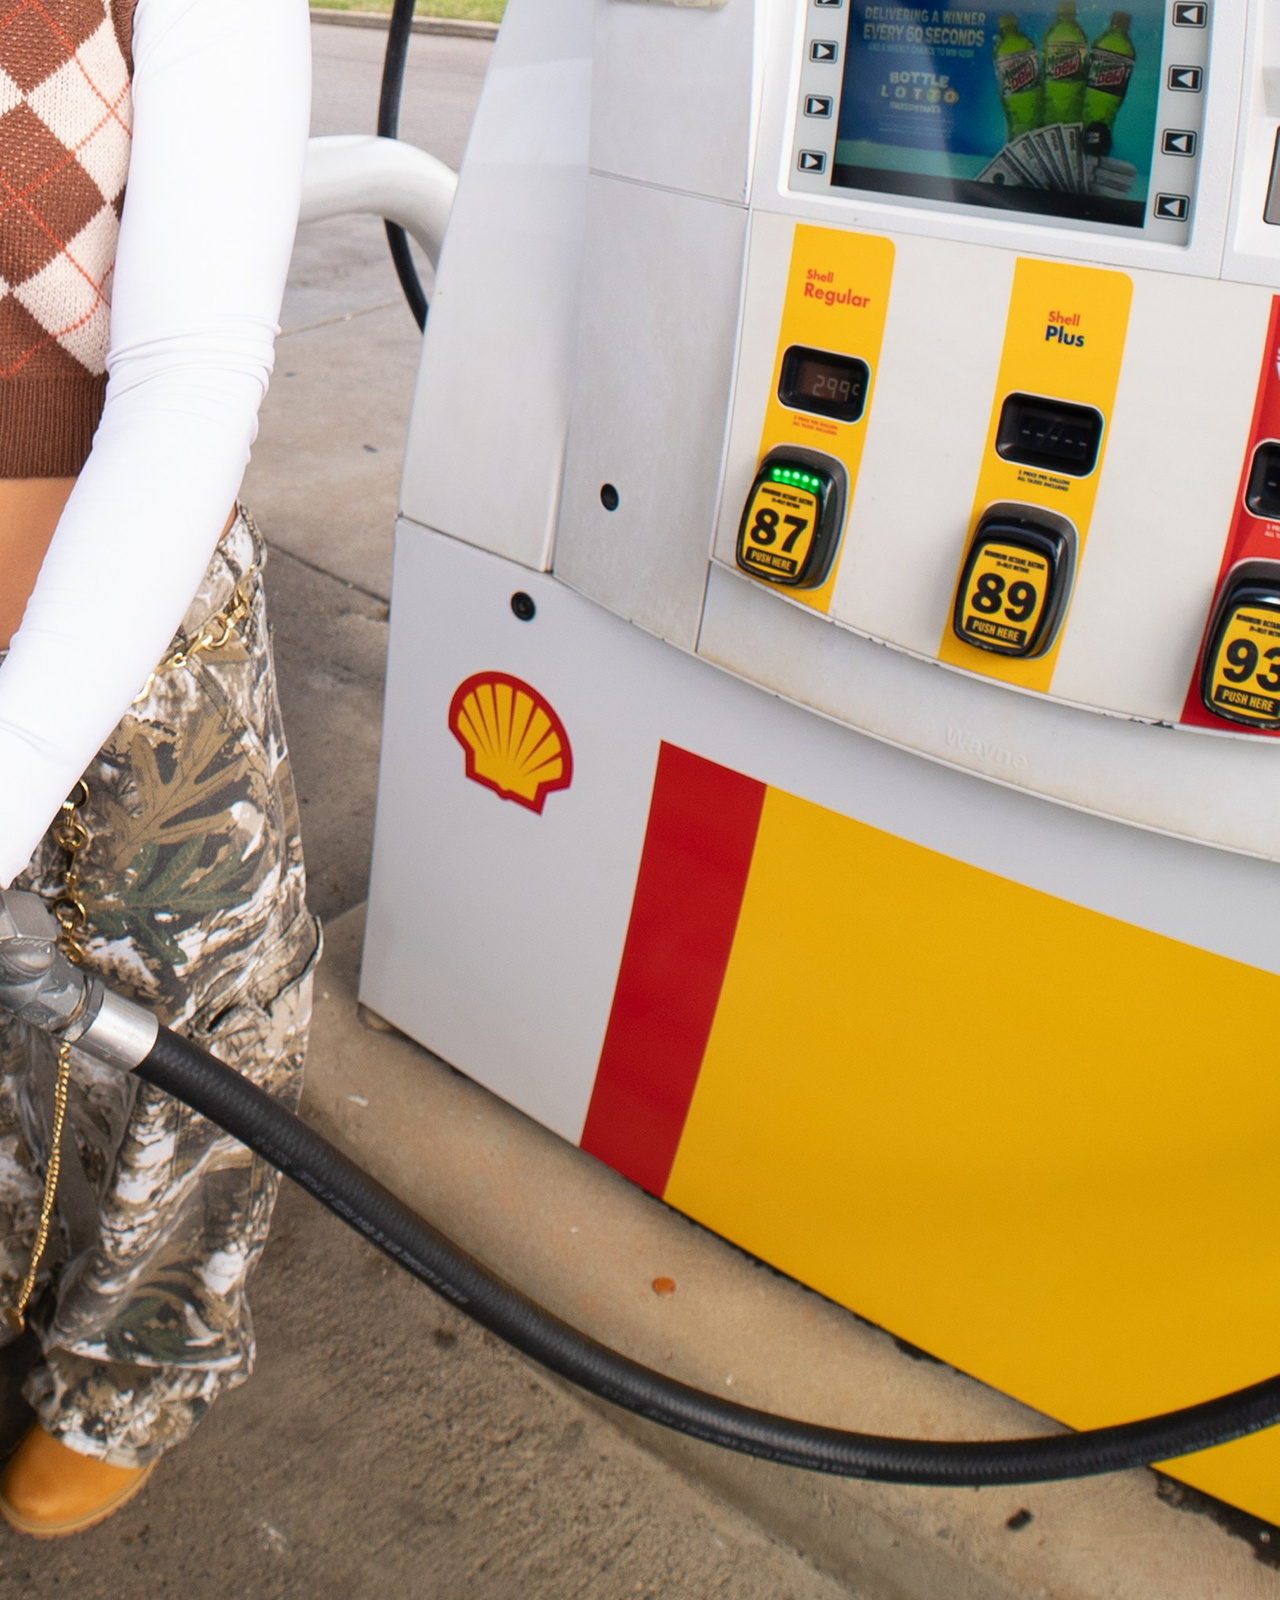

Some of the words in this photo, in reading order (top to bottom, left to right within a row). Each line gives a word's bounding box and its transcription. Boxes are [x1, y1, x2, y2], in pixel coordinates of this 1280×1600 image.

[864, 5, 929, 23] DELIVERING
[931, 10, 939, 23] A
[943, 10, 986, 26] WINNER
[863, 23, 905, 40] EVERY
[906, 25, 923, 43] 60
[925, 26, 985, 48] SECONDS
[890, 71, 950, 88] BOTTLE
[806, 268, 834, 283] Shell
[804, 282, 870, 308] Regular
[1048, 310, 1080, 327] Shell
[1045, 325, 1085, 347] Plus
[750, 507, 808, 553] 87
[751, 549, 771, 566] PUSH
[771, 555, 792, 571] HERE
[971, 572, 1037, 623] 89
[972, 619, 996, 636] PUSH
[996, 625, 1020, 642] HERE
[1223, 638, 1280, 693] 93
[1222, 688, 1249, 706] PUSH
[1249, 695, 1275, 713] HERE
[943, 722, 1029, 771] Wayne
